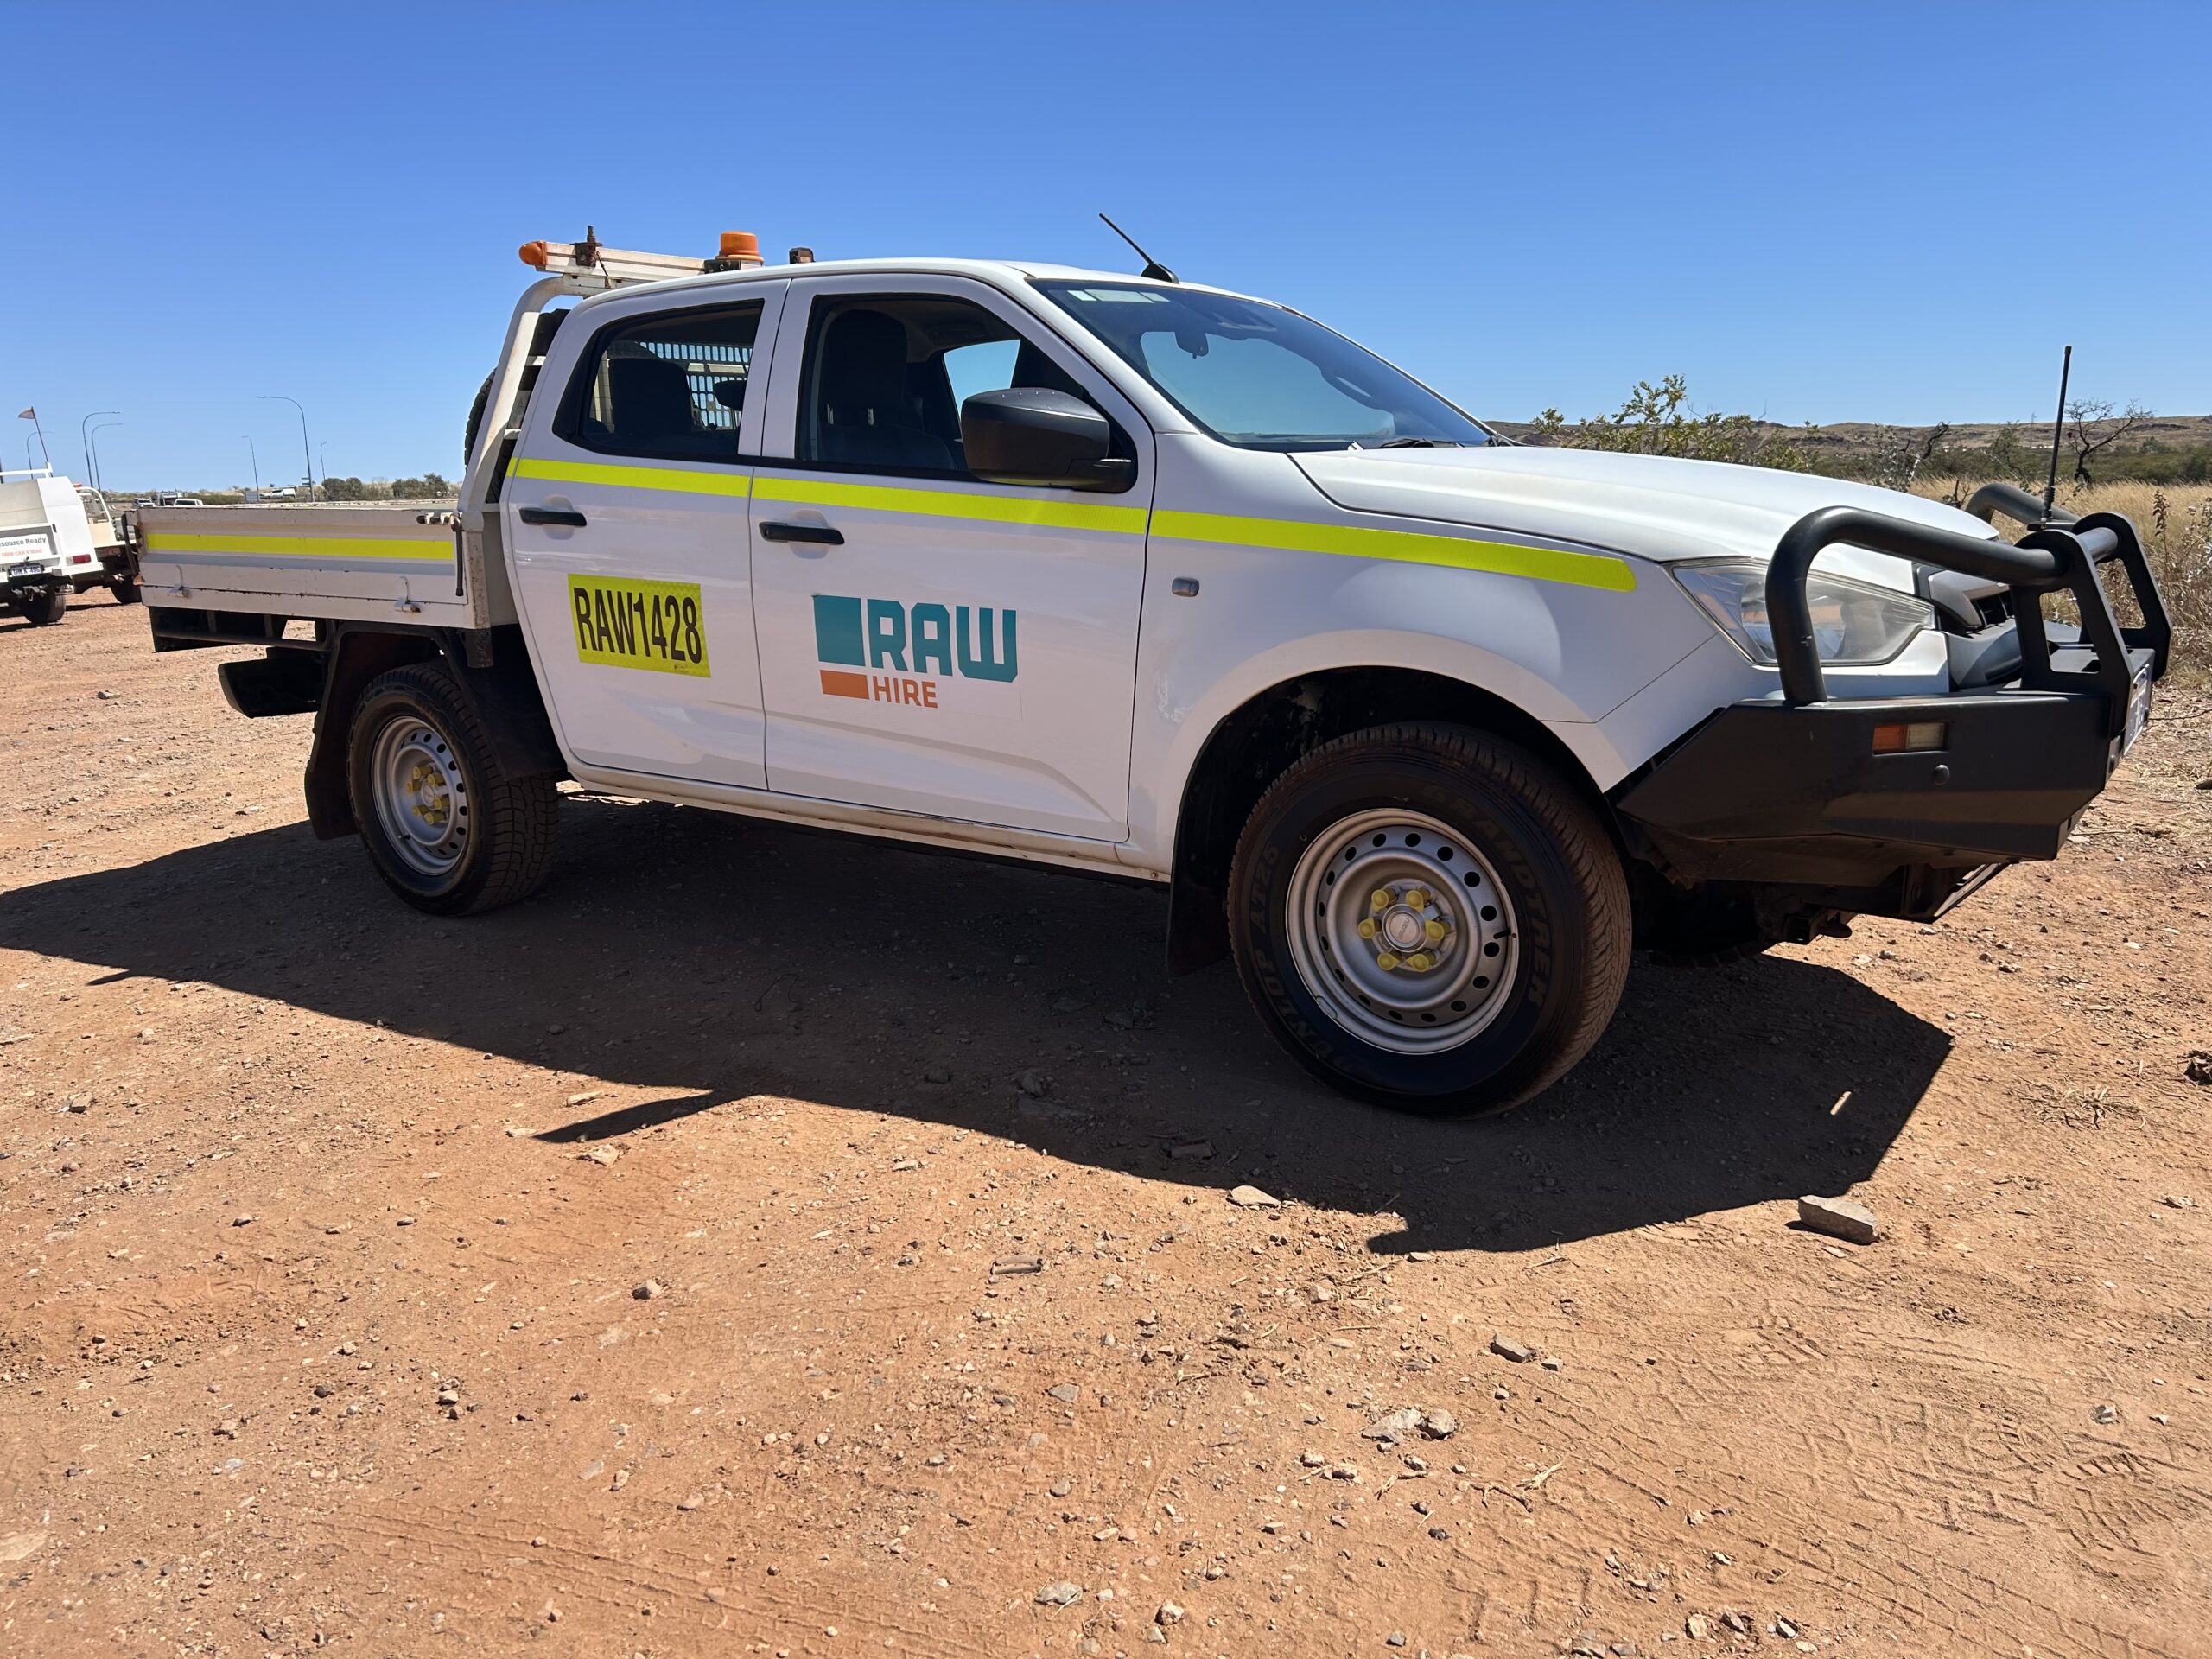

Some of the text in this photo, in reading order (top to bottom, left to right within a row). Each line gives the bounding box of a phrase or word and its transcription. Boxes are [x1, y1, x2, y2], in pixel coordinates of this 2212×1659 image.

[574, 588, 702, 664] RAW1428
[868, 598, 1018, 683] RAW
[873, 676, 938, 708] HIRE
[1421, 785, 1552, 1008] GRANDTREK
